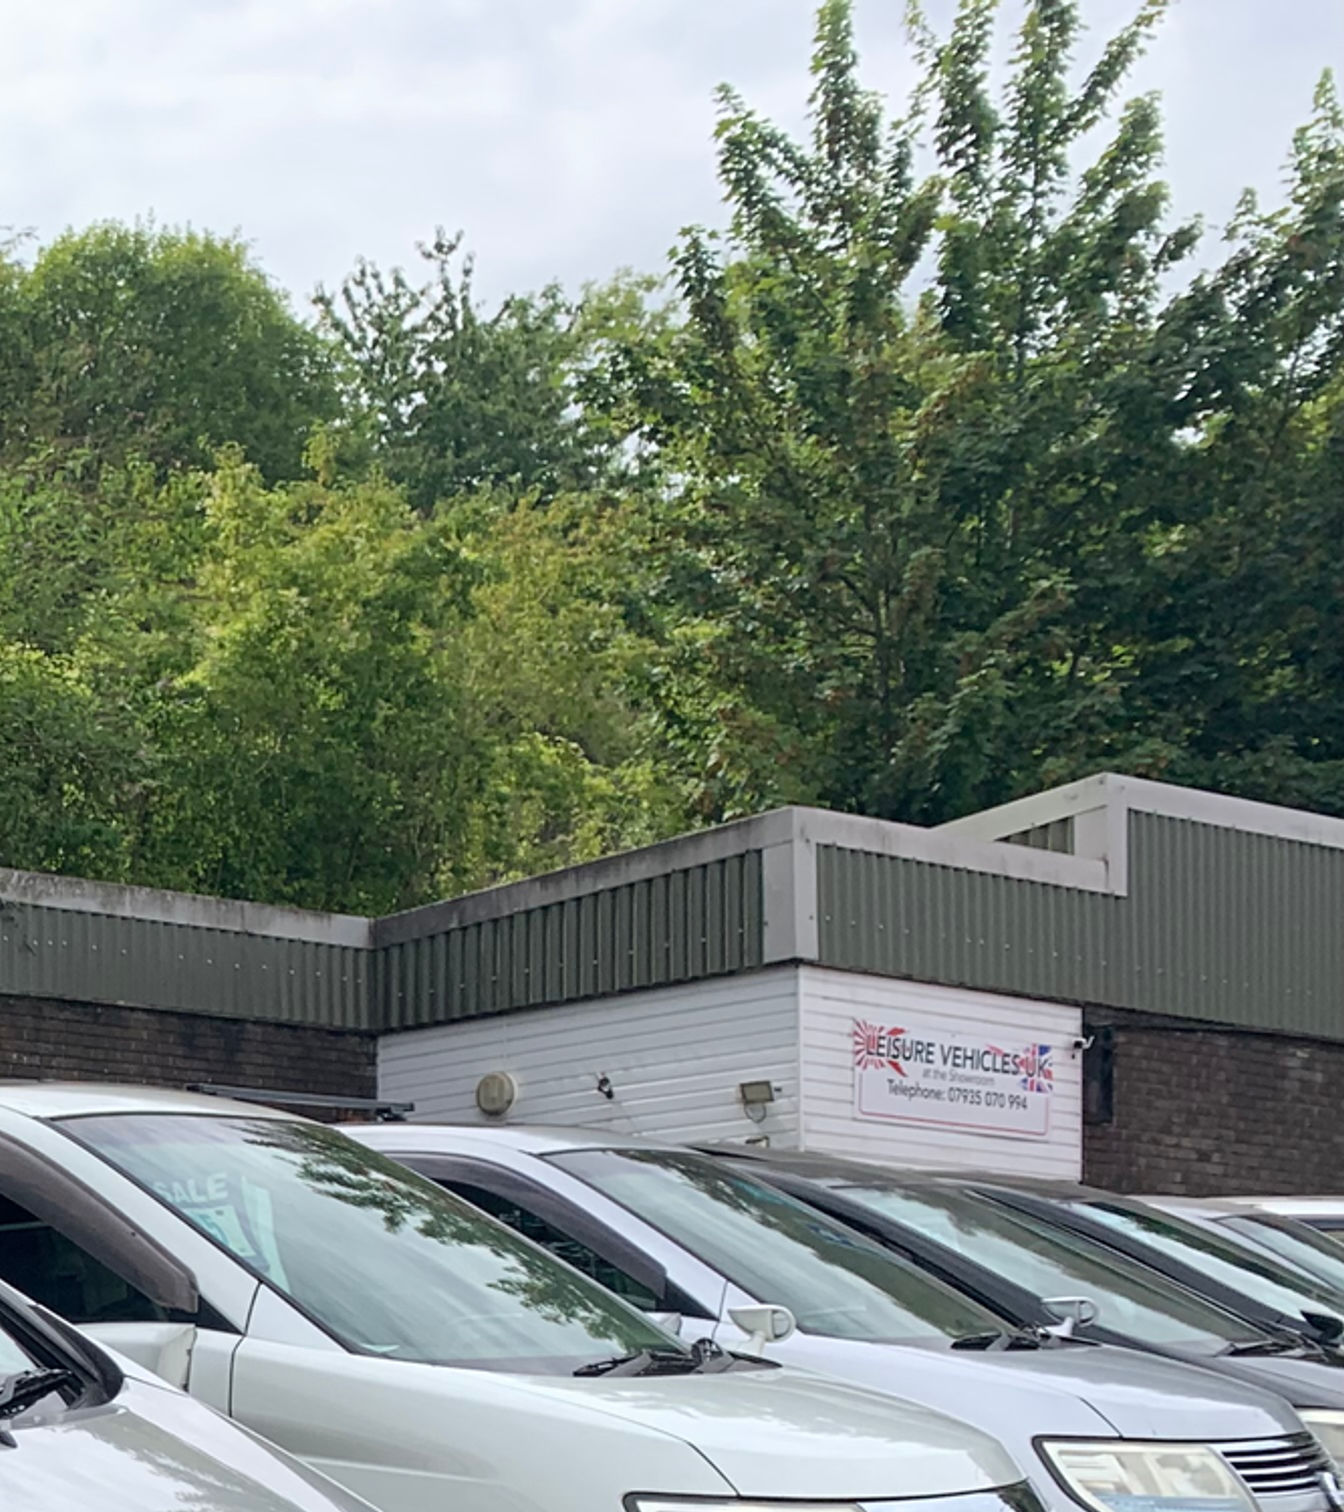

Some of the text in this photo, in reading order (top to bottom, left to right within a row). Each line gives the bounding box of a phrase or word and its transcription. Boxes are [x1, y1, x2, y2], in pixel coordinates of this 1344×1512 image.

[865, 1034, 1049, 1078] LEISURE VEHICLES UK
[887, 1078, 1028, 1111] Telephone: 07935 070 994
[153, 1172, 229, 1203] SALE
